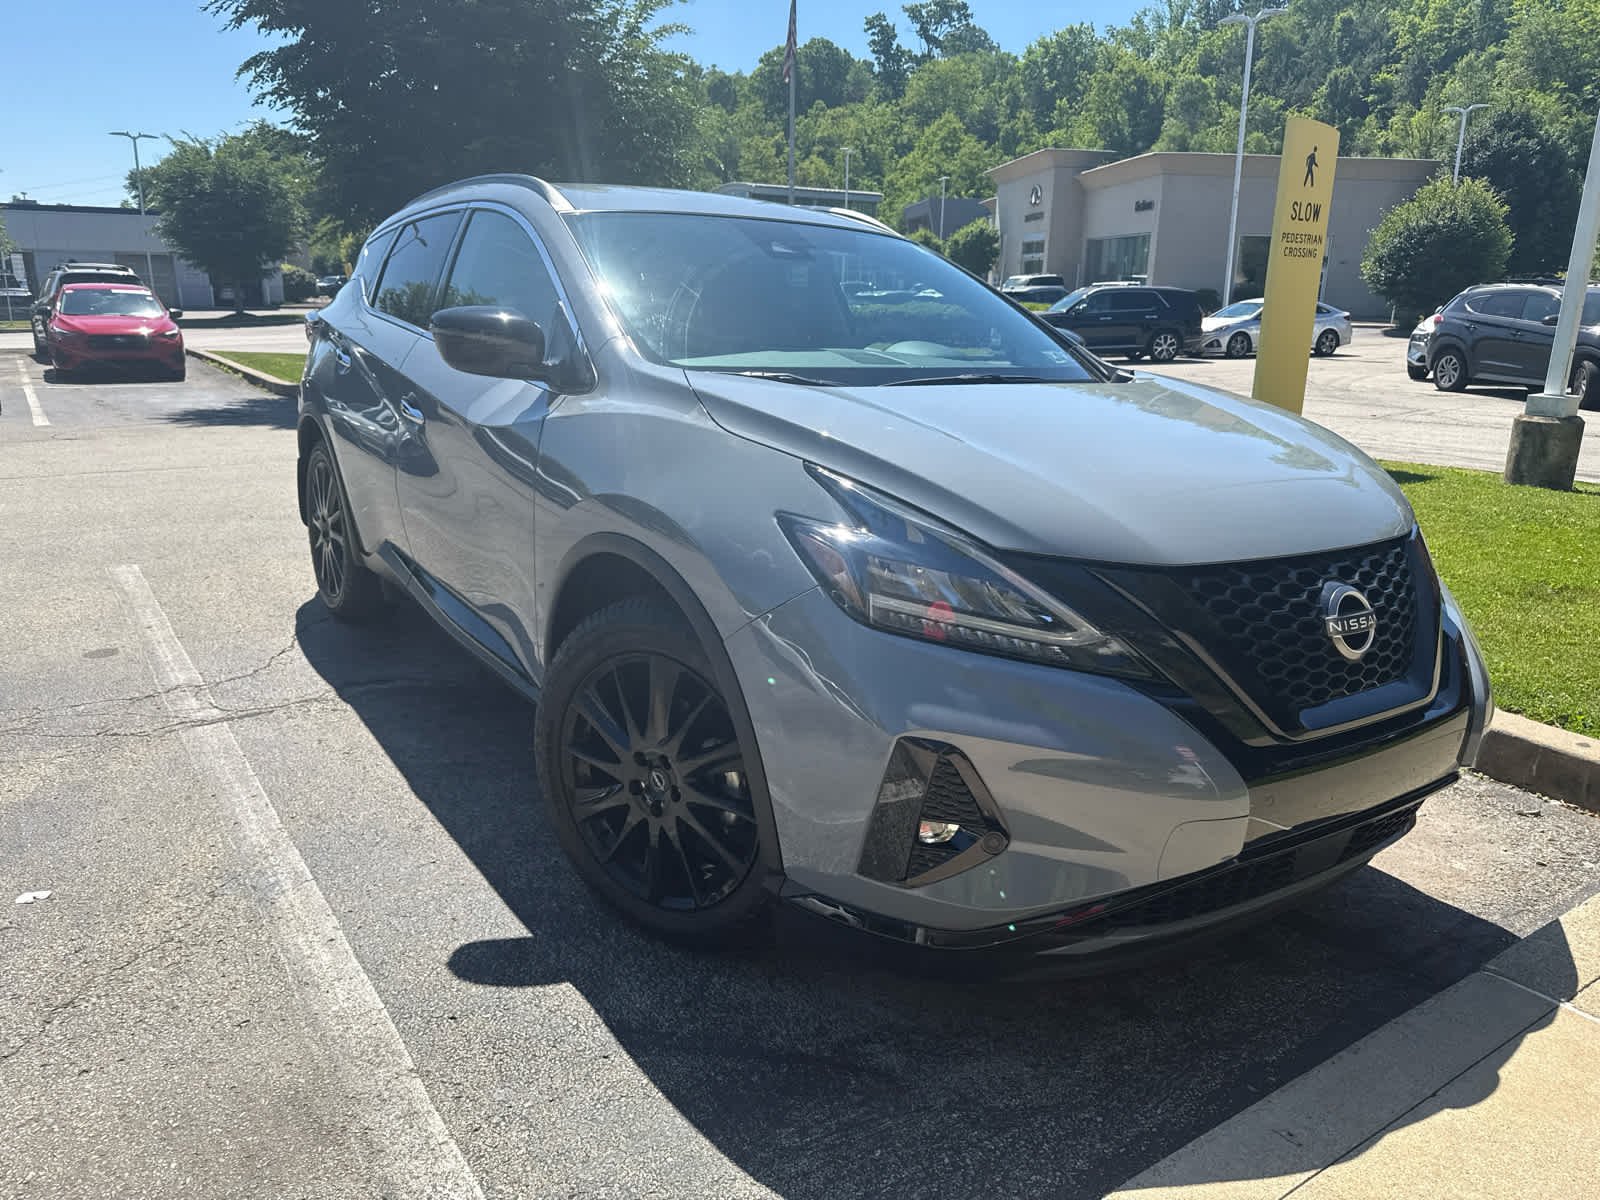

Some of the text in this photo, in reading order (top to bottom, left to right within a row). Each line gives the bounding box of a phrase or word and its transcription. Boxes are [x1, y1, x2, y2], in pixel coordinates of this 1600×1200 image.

[1290, 201, 1321, 222] SLOW
[1281, 232, 1322, 245] PEDESTRIAN
[1283, 246, 1317, 258] CROSSING
